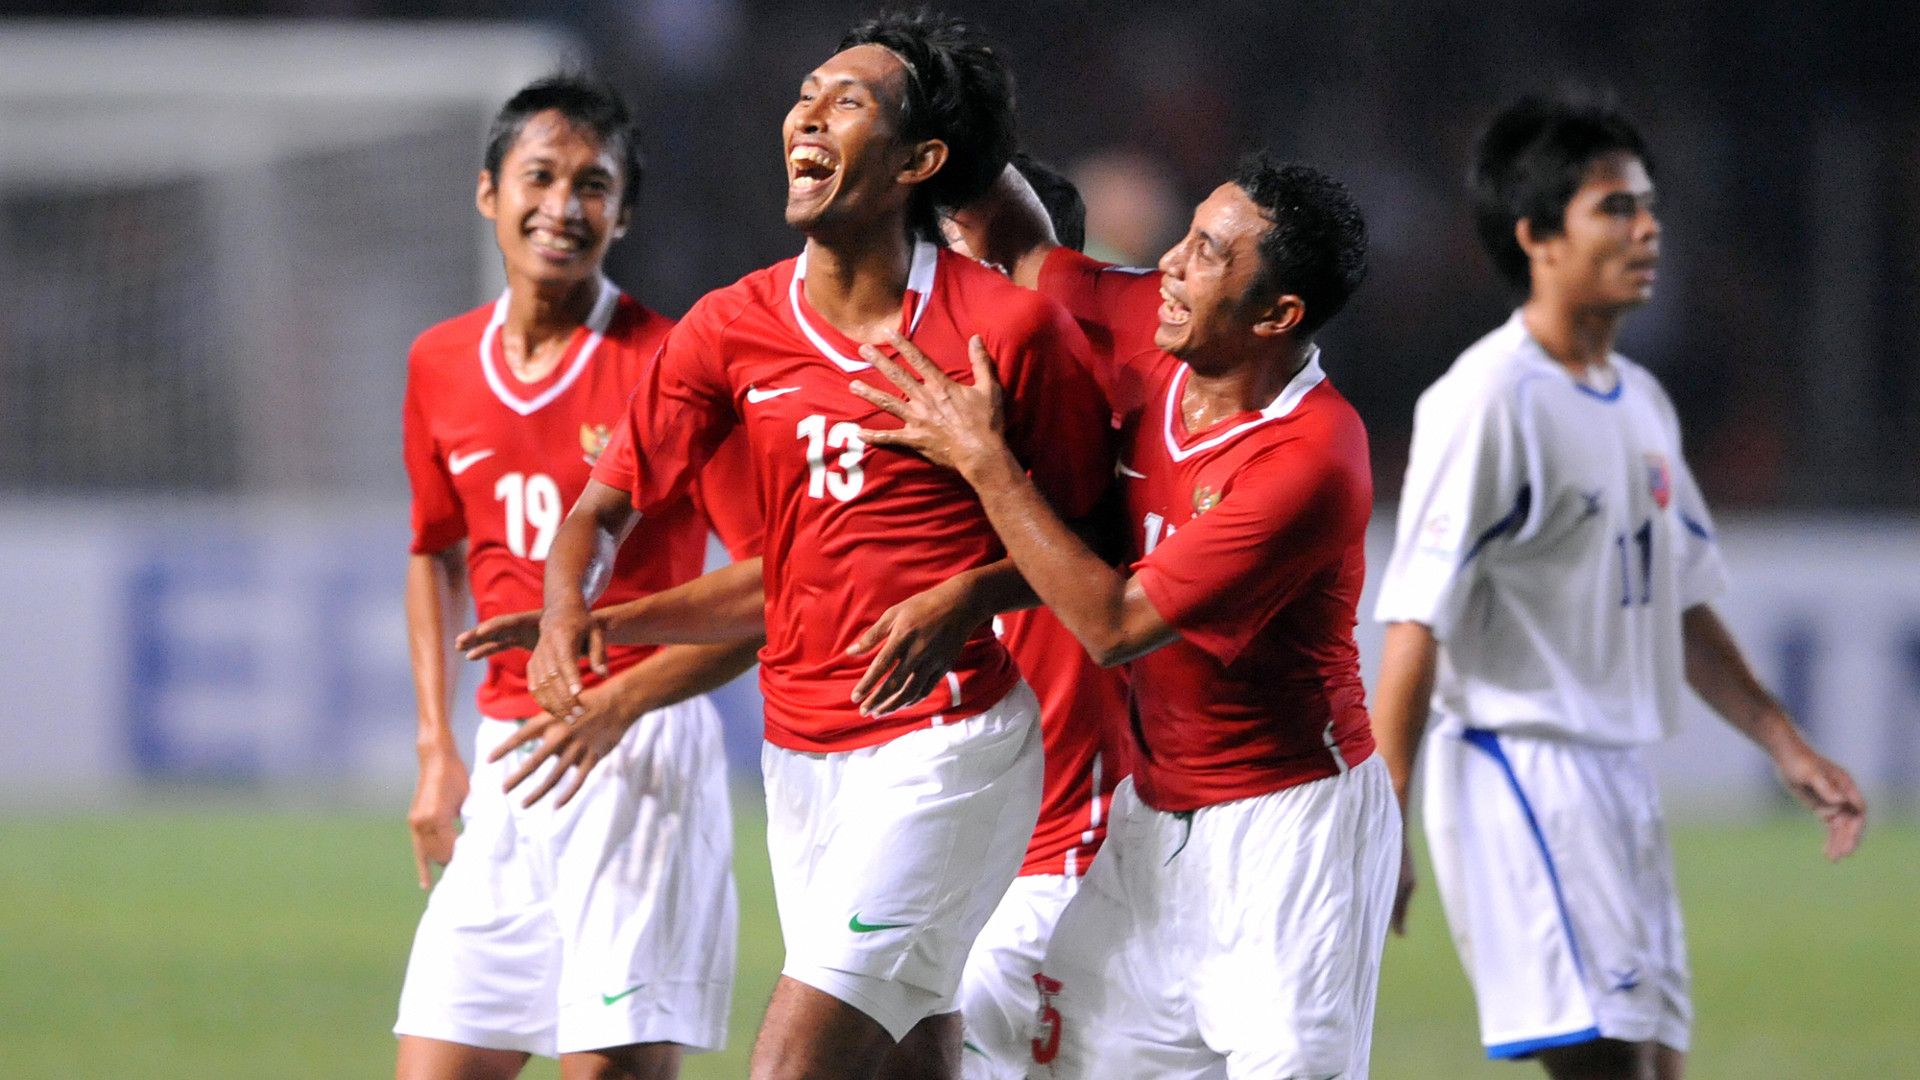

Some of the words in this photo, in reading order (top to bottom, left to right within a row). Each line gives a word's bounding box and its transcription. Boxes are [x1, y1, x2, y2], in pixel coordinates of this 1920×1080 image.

[796, 414, 865, 502] 13
[494, 472, 562, 561] 19
[1143, 511, 1177, 556] 1
[1615, 518, 1652, 607] 11
